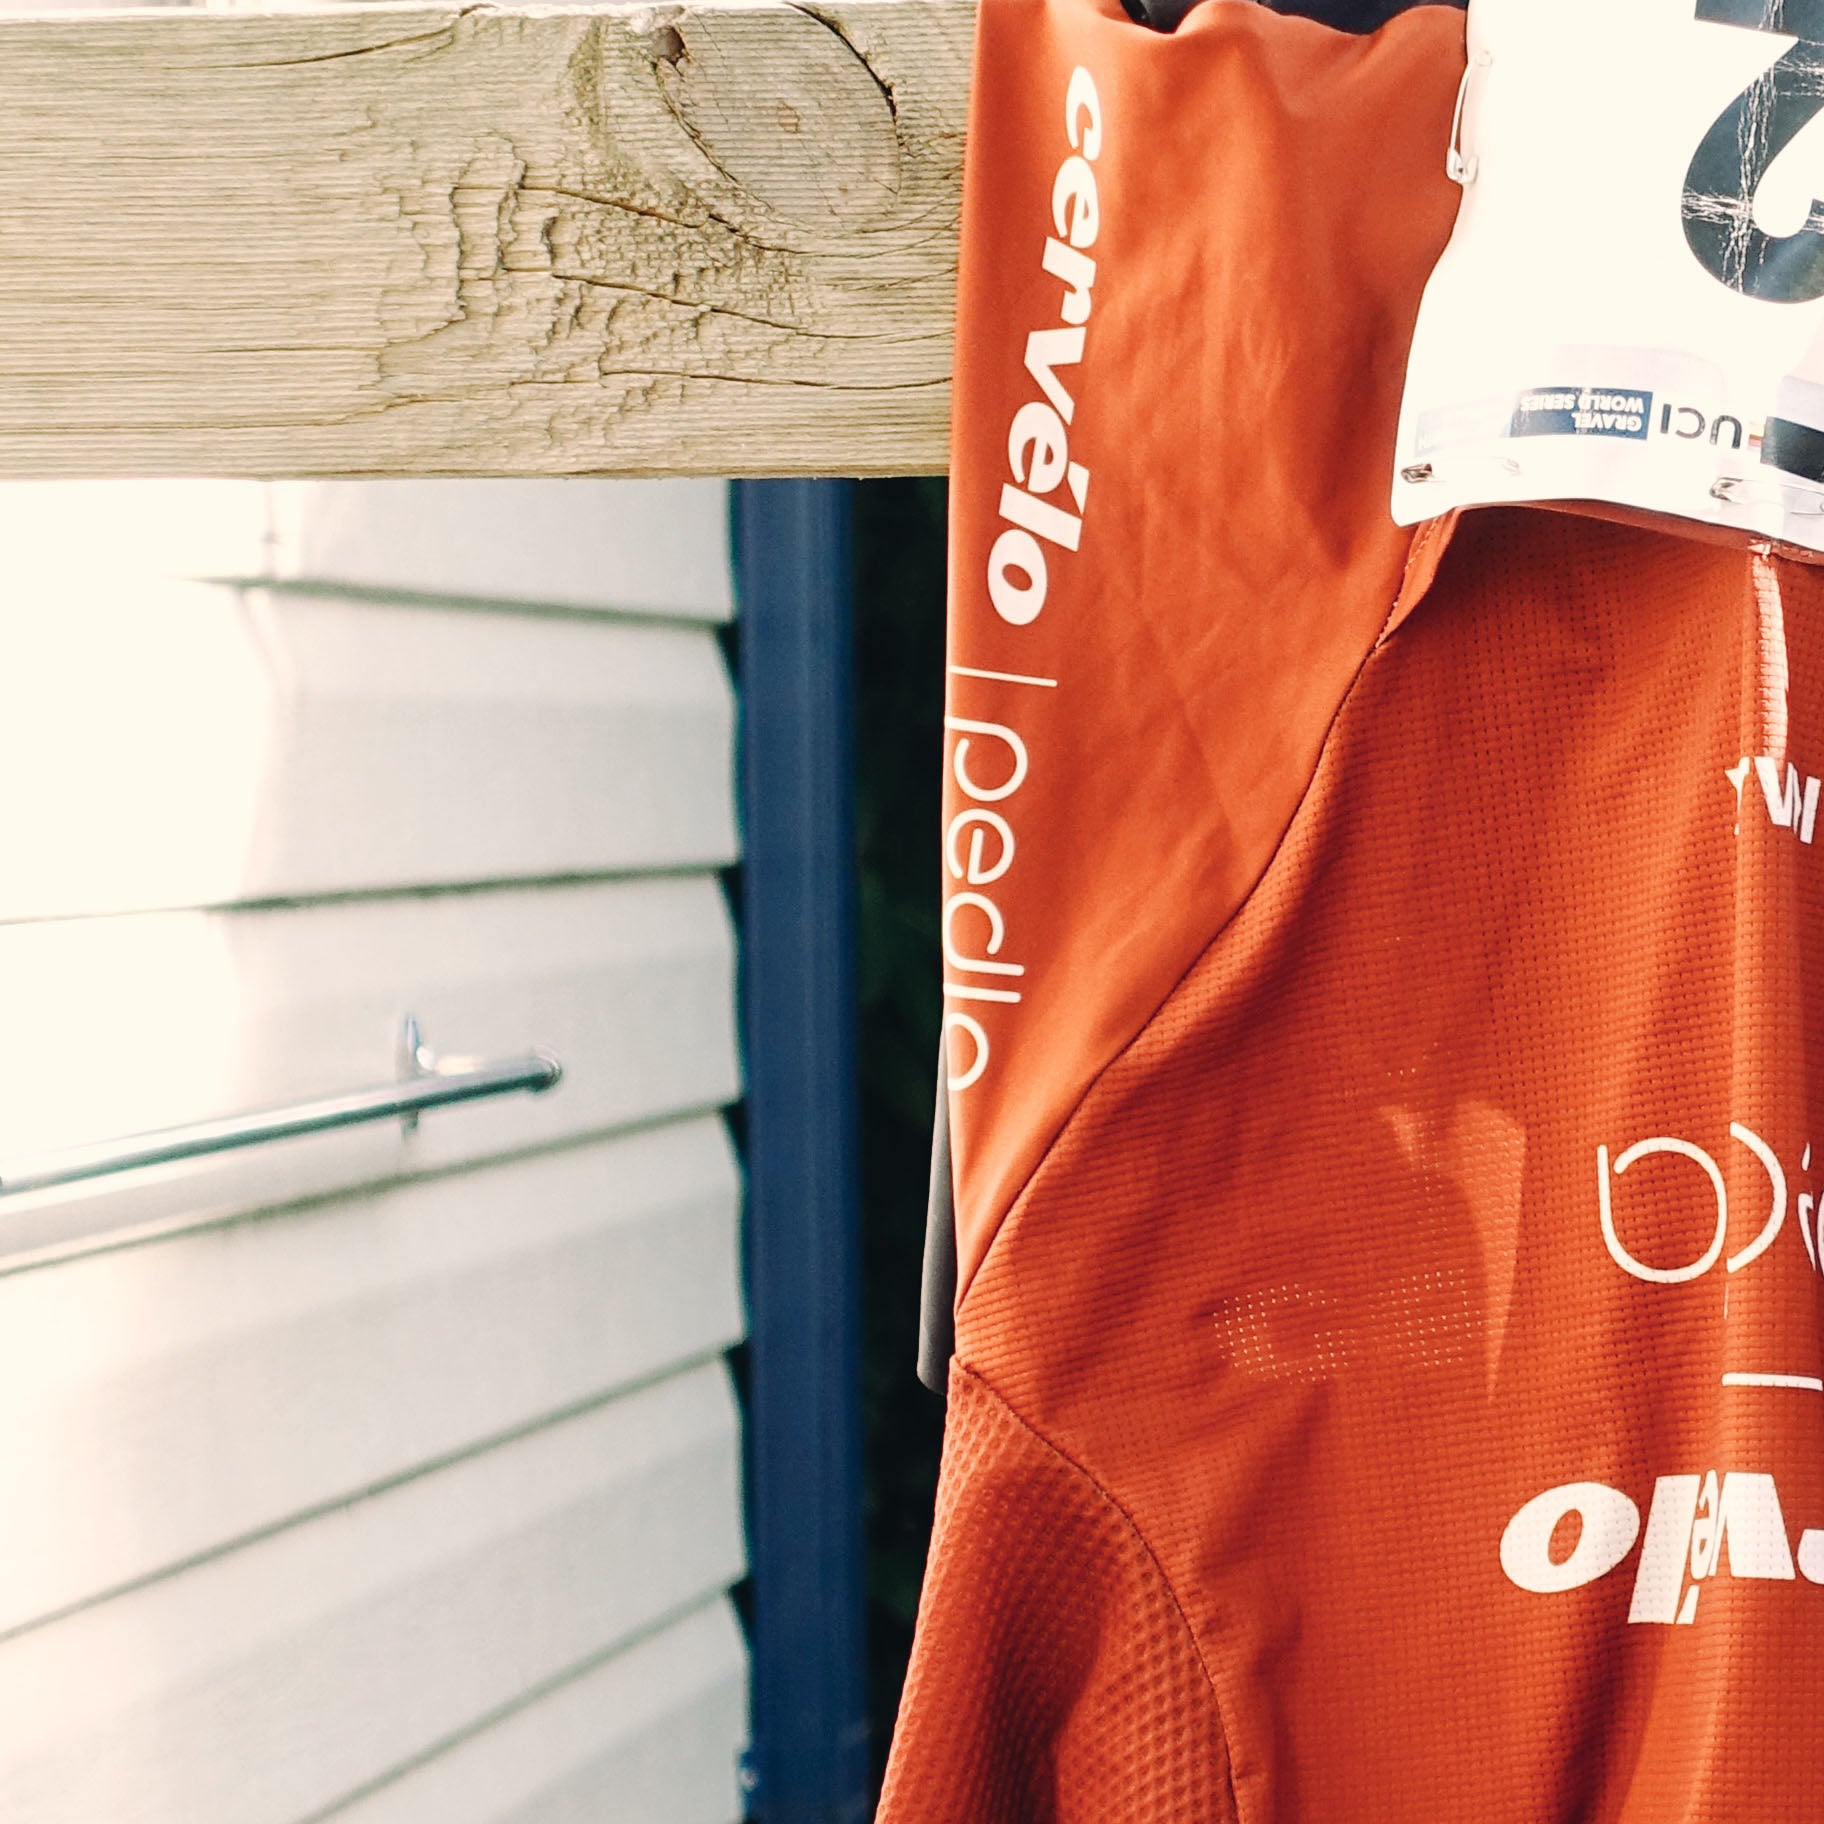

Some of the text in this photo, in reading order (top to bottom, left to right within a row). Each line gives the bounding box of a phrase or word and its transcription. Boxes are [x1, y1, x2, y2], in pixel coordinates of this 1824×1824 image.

[987, 65, 1103, 626] cervélo
[1519, 392, 1645, 415] WORLD SERIES
[1571, 411, 1643, 434] GRAVEL
[1661, 402, 1742, 449] UCI
